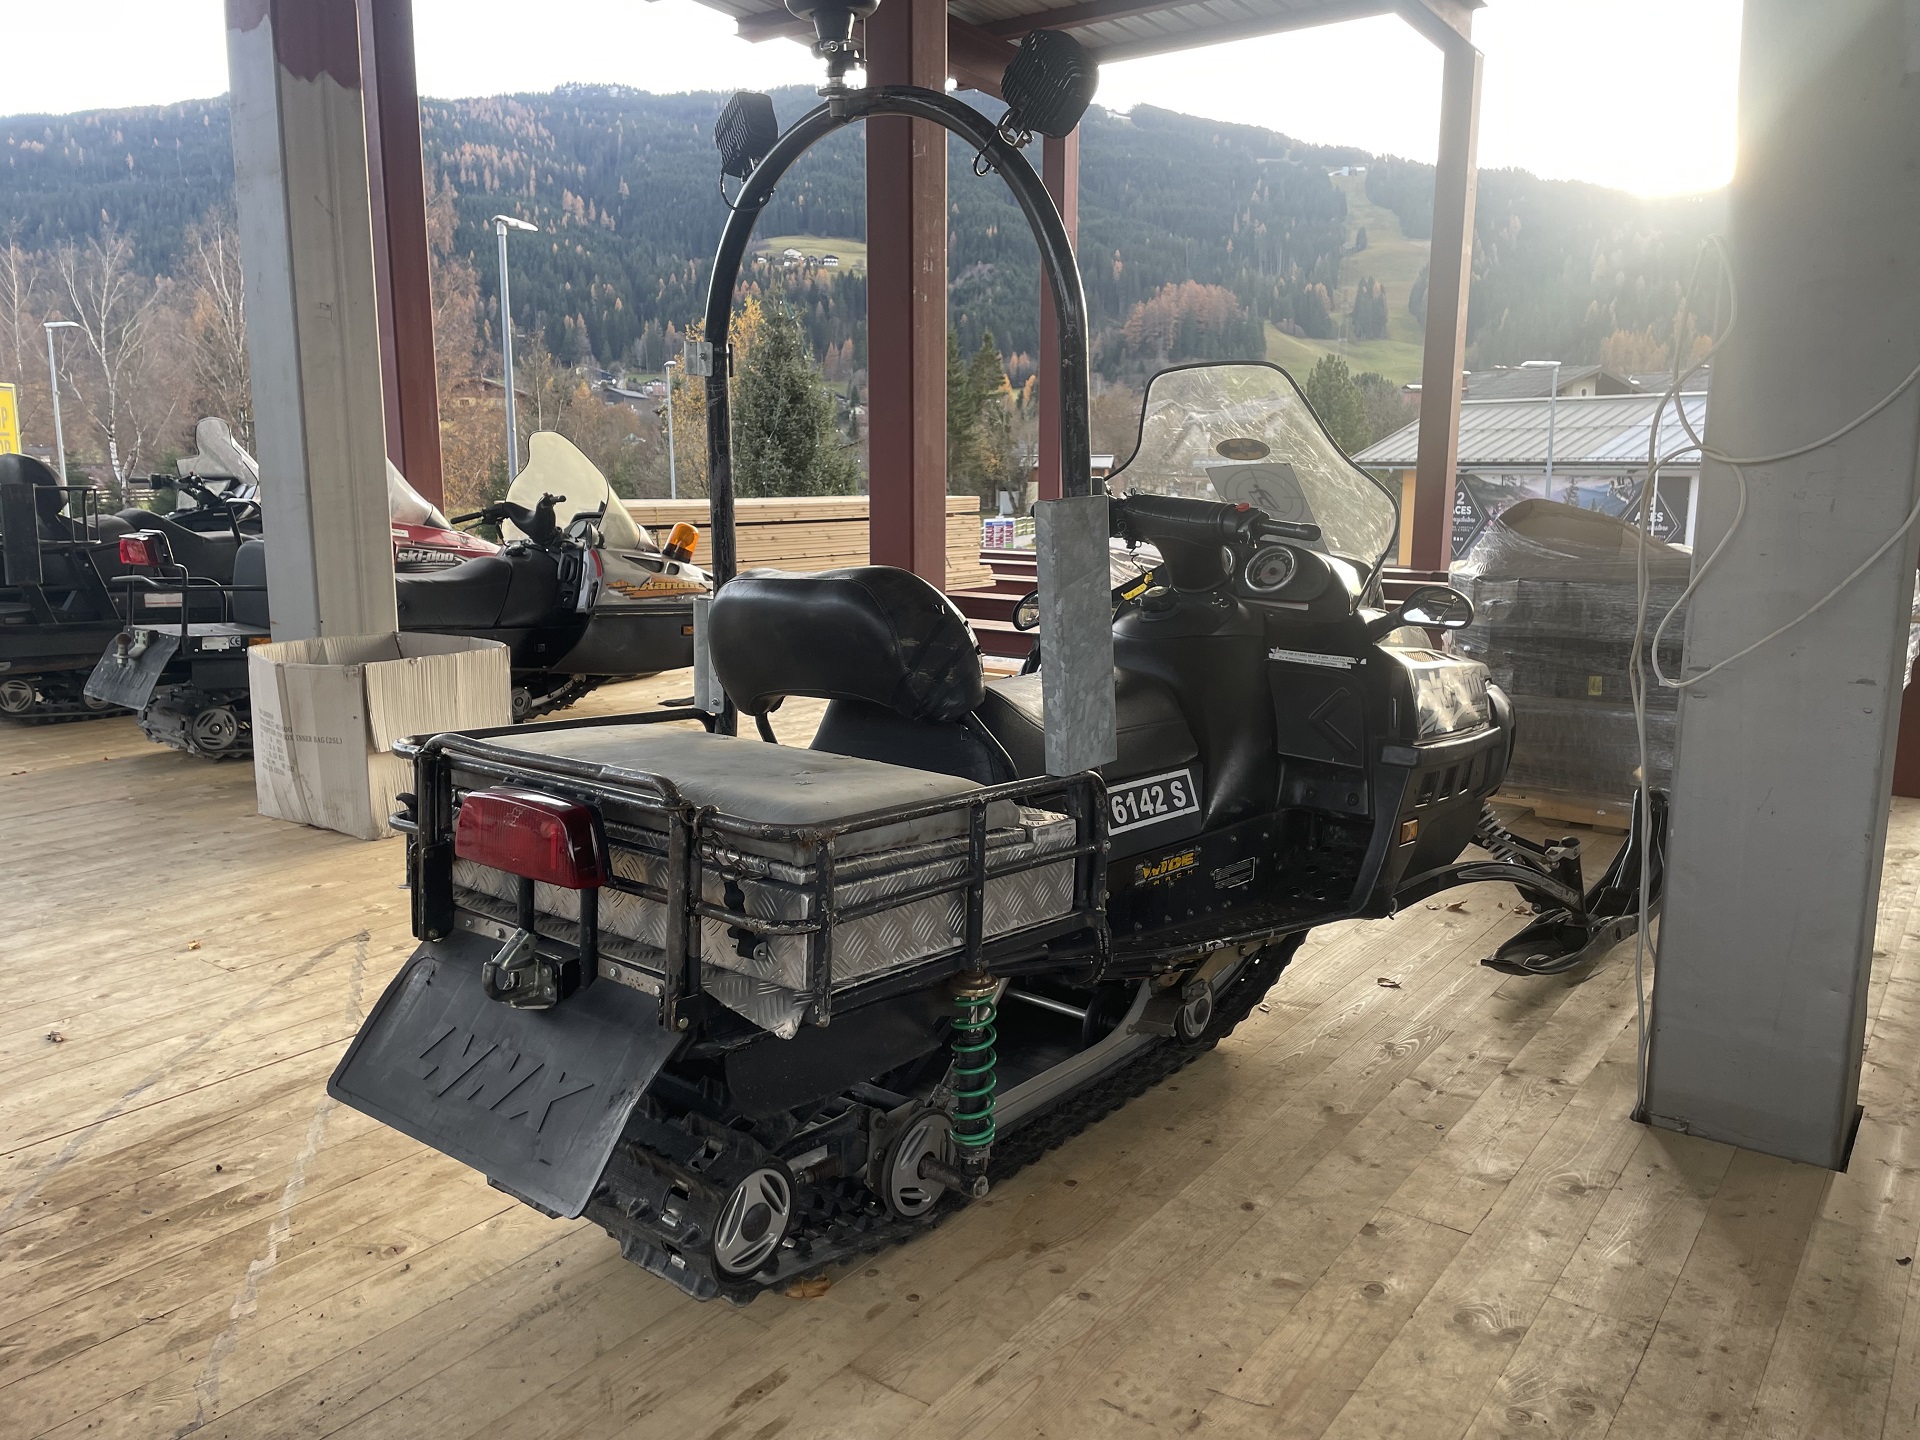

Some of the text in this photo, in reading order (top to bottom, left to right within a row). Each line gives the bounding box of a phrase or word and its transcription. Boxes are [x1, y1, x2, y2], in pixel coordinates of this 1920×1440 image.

[1457, 492, 1465, 505] 2
[1453, 505, 1472, 515] CES
[397, 549, 454, 563] ski-doo
[326, 736, 343, 744] (25L)
[1111, 780, 1187, 824] 6142 S
[1142, 852, 1194, 879] WIDE
[404, 1022, 595, 1134] LYNX
